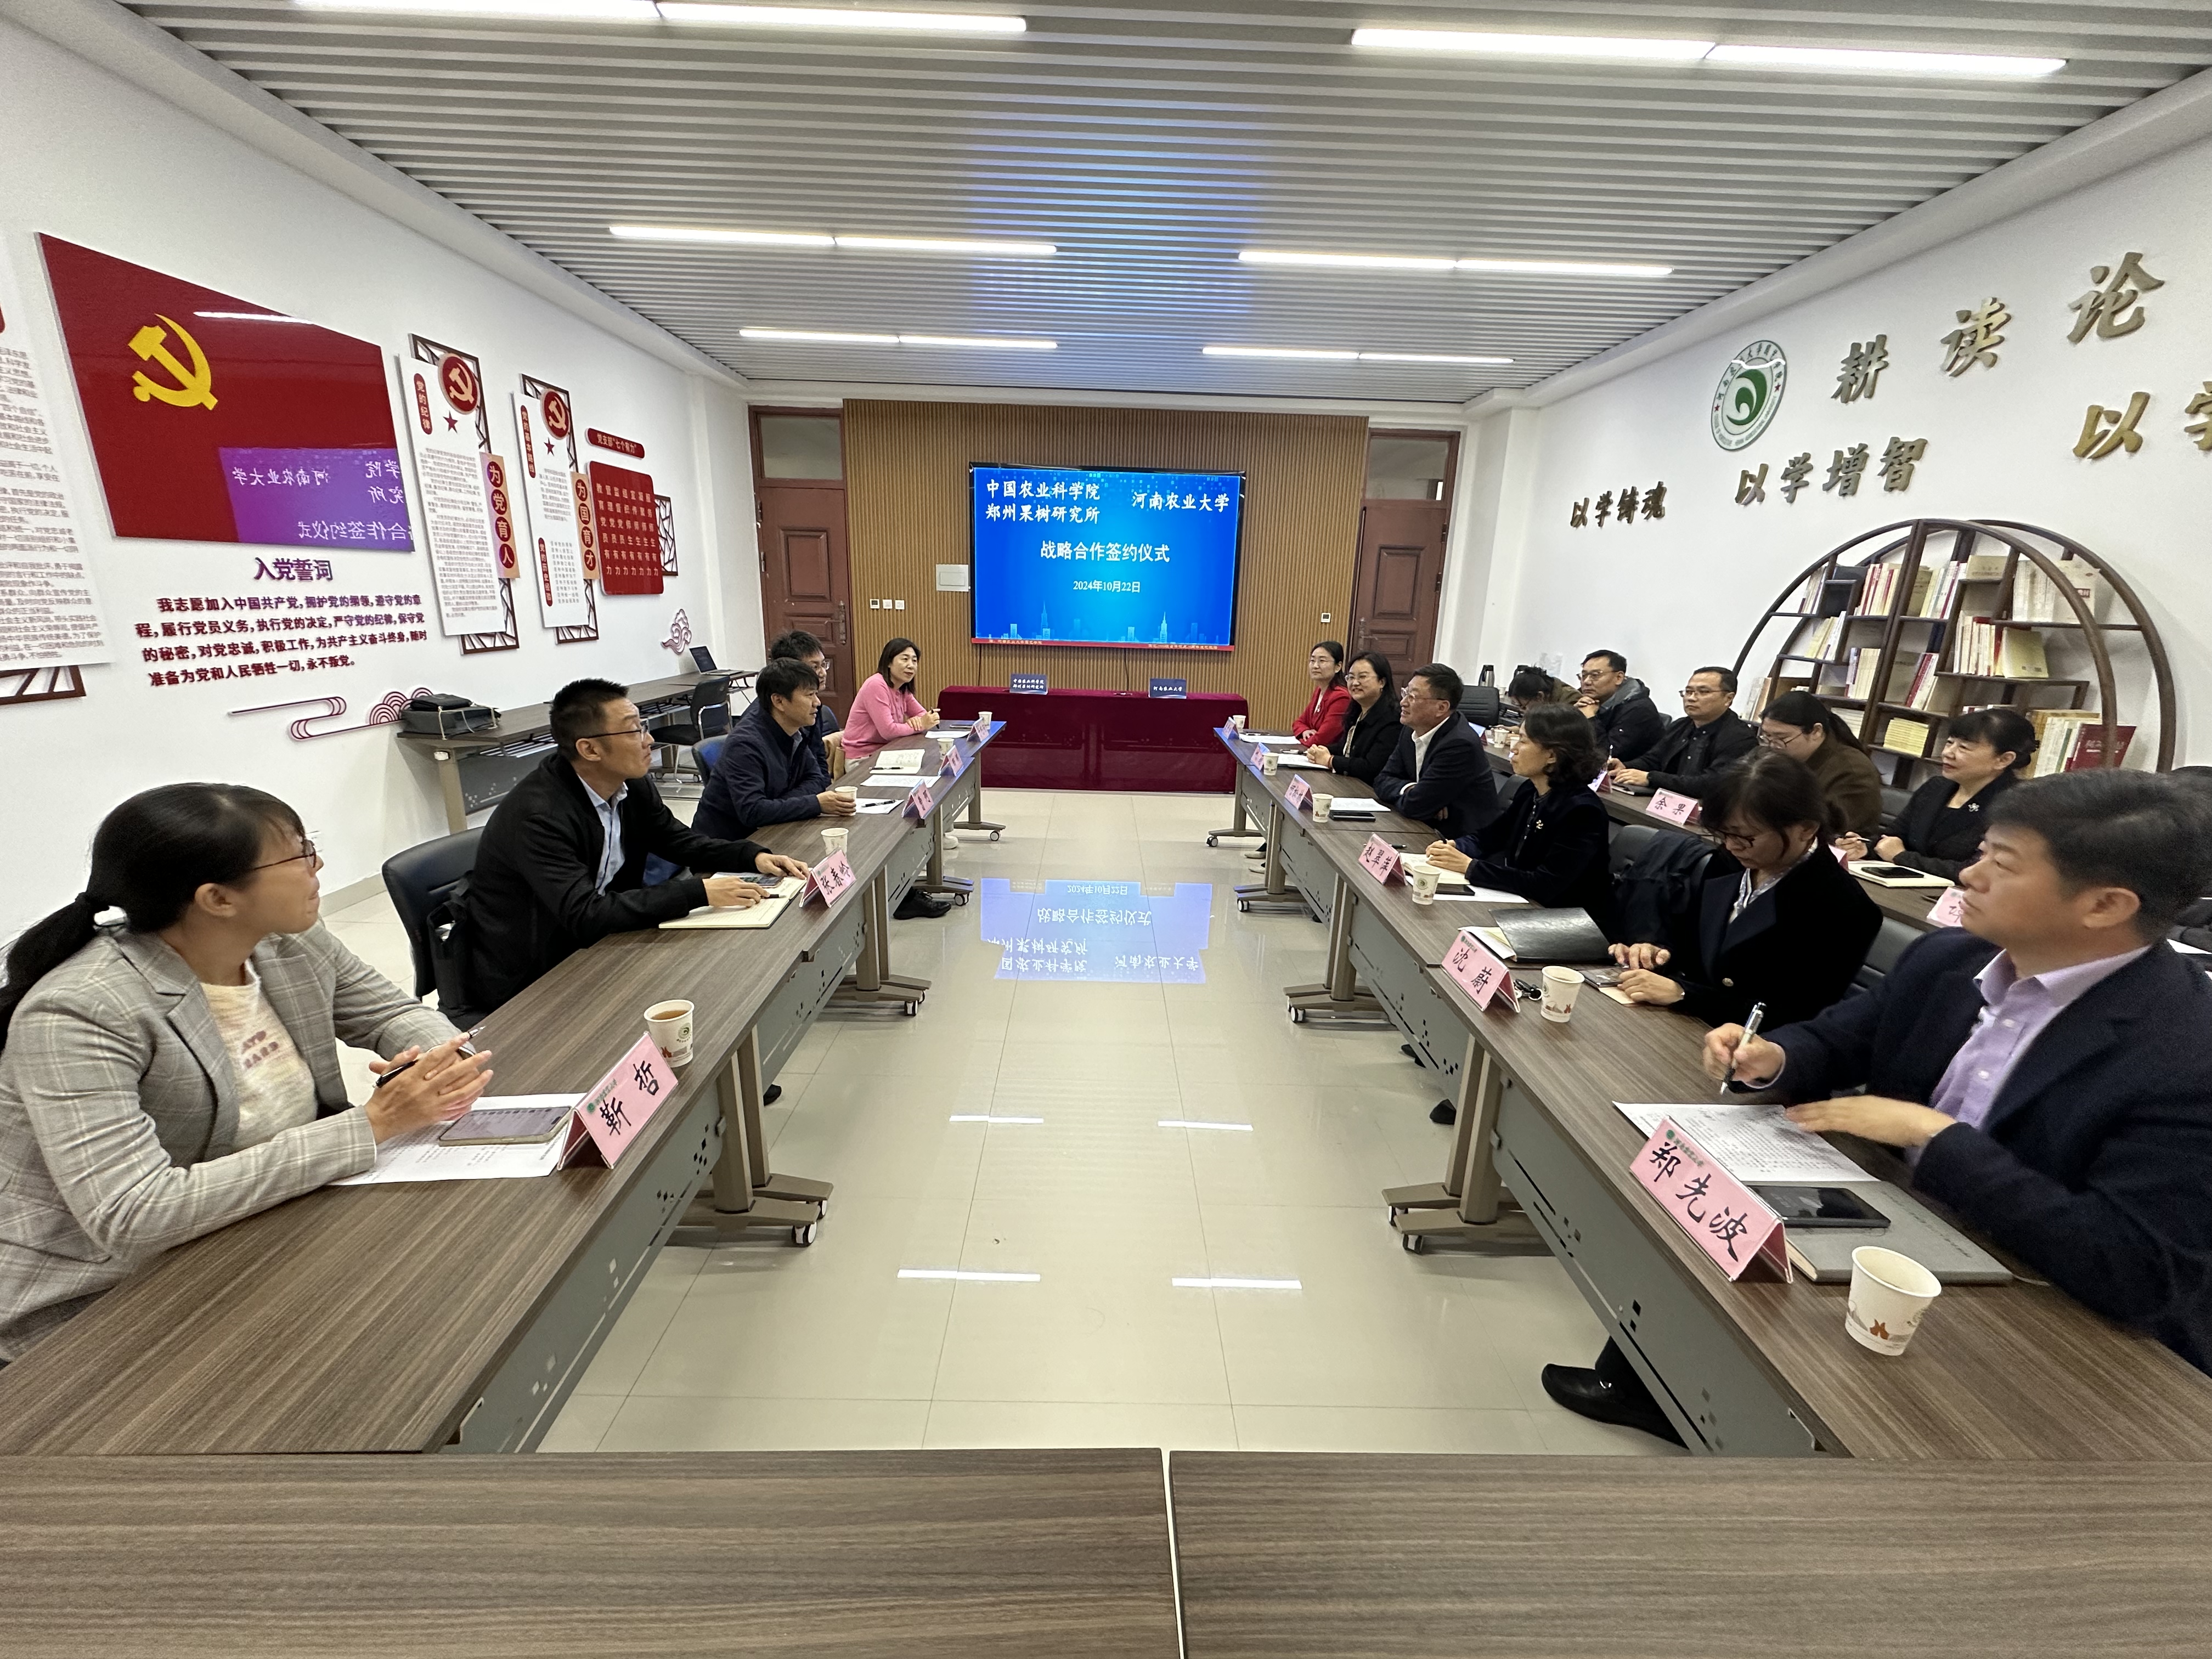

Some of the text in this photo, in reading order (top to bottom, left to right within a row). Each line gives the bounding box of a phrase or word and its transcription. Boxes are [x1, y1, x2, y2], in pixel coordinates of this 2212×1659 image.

[416, 381, 431, 430] 党的纪律
[986, 478, 1100, 500] 中国农业科学院
[1734, 436, 1928, 505] 以学增智
[489, 464, 514, 565] 为党育人
[576, 481, 594, 567] 为国育才
[985, 504, 1100, 523] 郑州果树研究所
[1131, 492, 1230, 513] 河南农业大学
[1570, 481, 1667, 528] 以学铸魂
[253, 557, 334, 581] 入党誓词
[1040, 540, 1170, 562] 战略合作签约仪式
[1073, 580, 1141, 593] 2024年10月22日
[1452, 947, 1492, 994] 沈蔚
[600, 1060, 659, 1136] 靳哲
[1649, 1142, 1748, 1262] 郑先波
